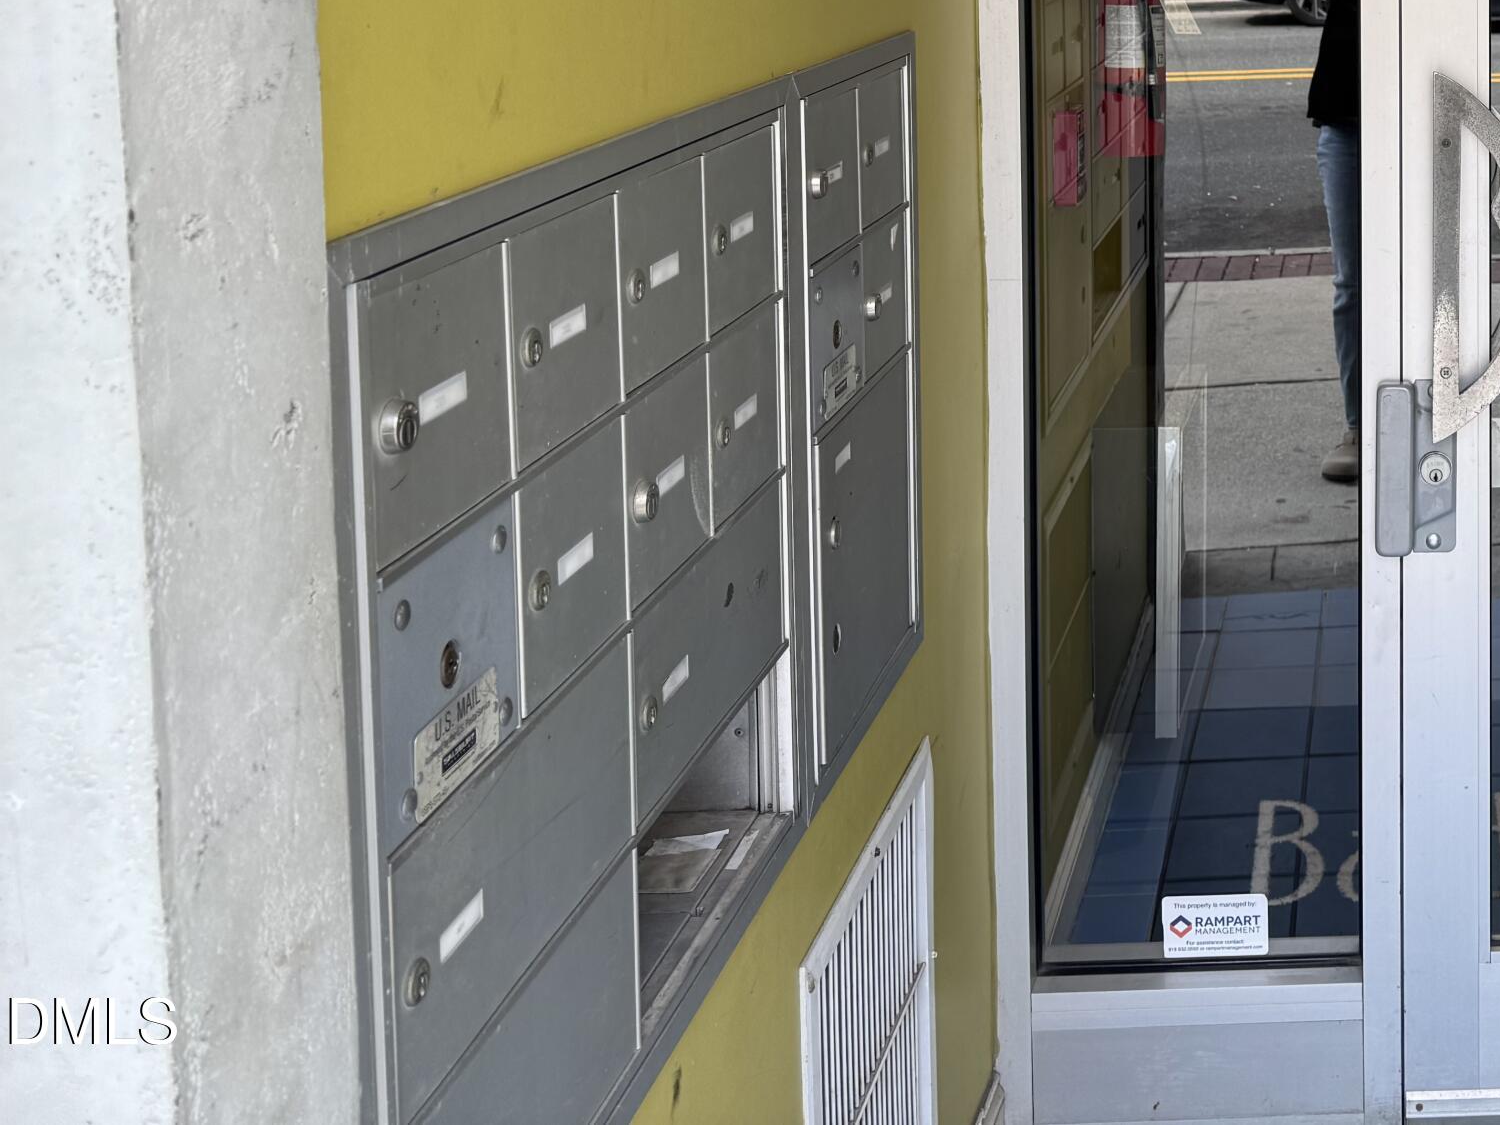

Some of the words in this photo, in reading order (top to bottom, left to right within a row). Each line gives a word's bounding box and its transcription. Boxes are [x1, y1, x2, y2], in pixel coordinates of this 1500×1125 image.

[434, 711, 454, 742] U.S.
[456, 686, 481, 723] MAIL
[1187, 902, 1212, 910] property
[1219, 901, 1247, 909] managed
[1195, 915, 1261, 927] RAMPART
[1195, 926, 1261, 935] MANAGEMENT
